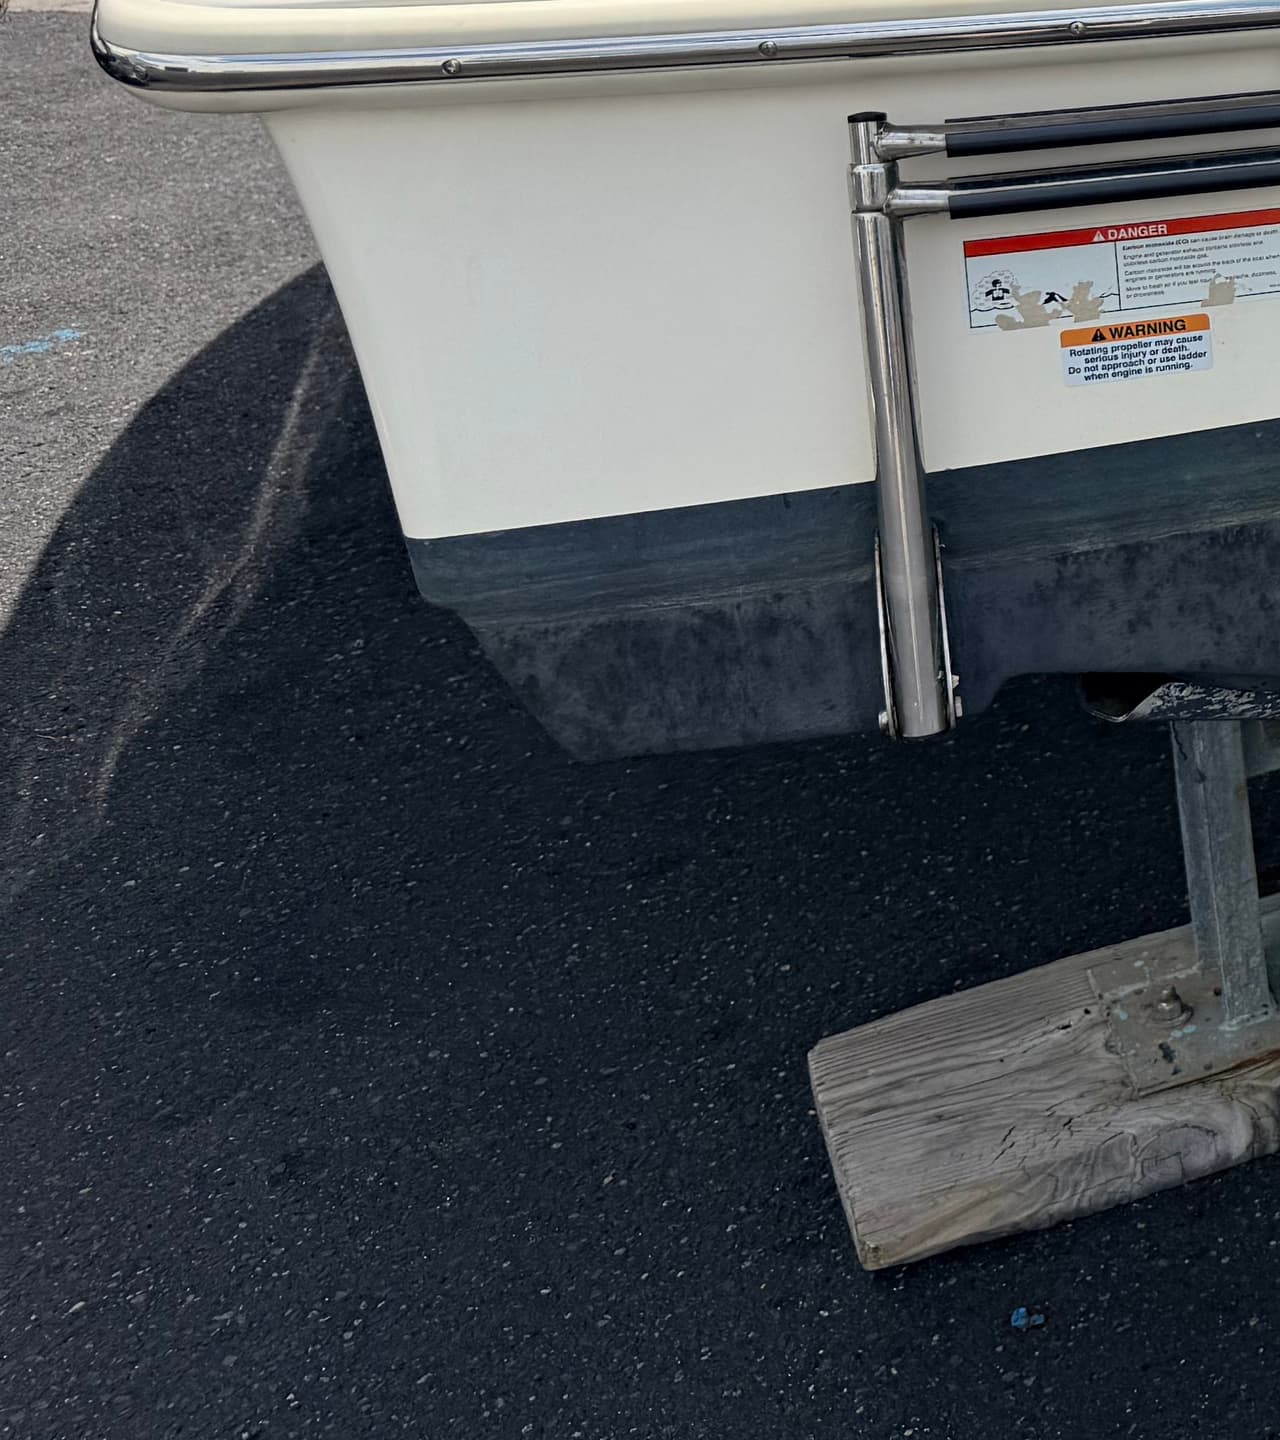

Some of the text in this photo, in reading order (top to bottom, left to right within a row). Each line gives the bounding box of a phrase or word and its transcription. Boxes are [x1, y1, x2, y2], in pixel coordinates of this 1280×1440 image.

[1107, 224, 1168, 240] DANGER
[1109, 319, 1186, 339] WARNING
[1069, 335, 1203, 358] Rotating propeller may cause
[1084, 344, 1190, 364] serious injury or death.
[1068, 366, 1081, 375] Do
[1084, 364, 1099, 373] not
[1101, 358, 1145, 372] approach
[1147, 357, 1158, 365] or
[1178, 350, 1208, 361] ladder
[1084, 361, 1193, 382] when engine is running.
